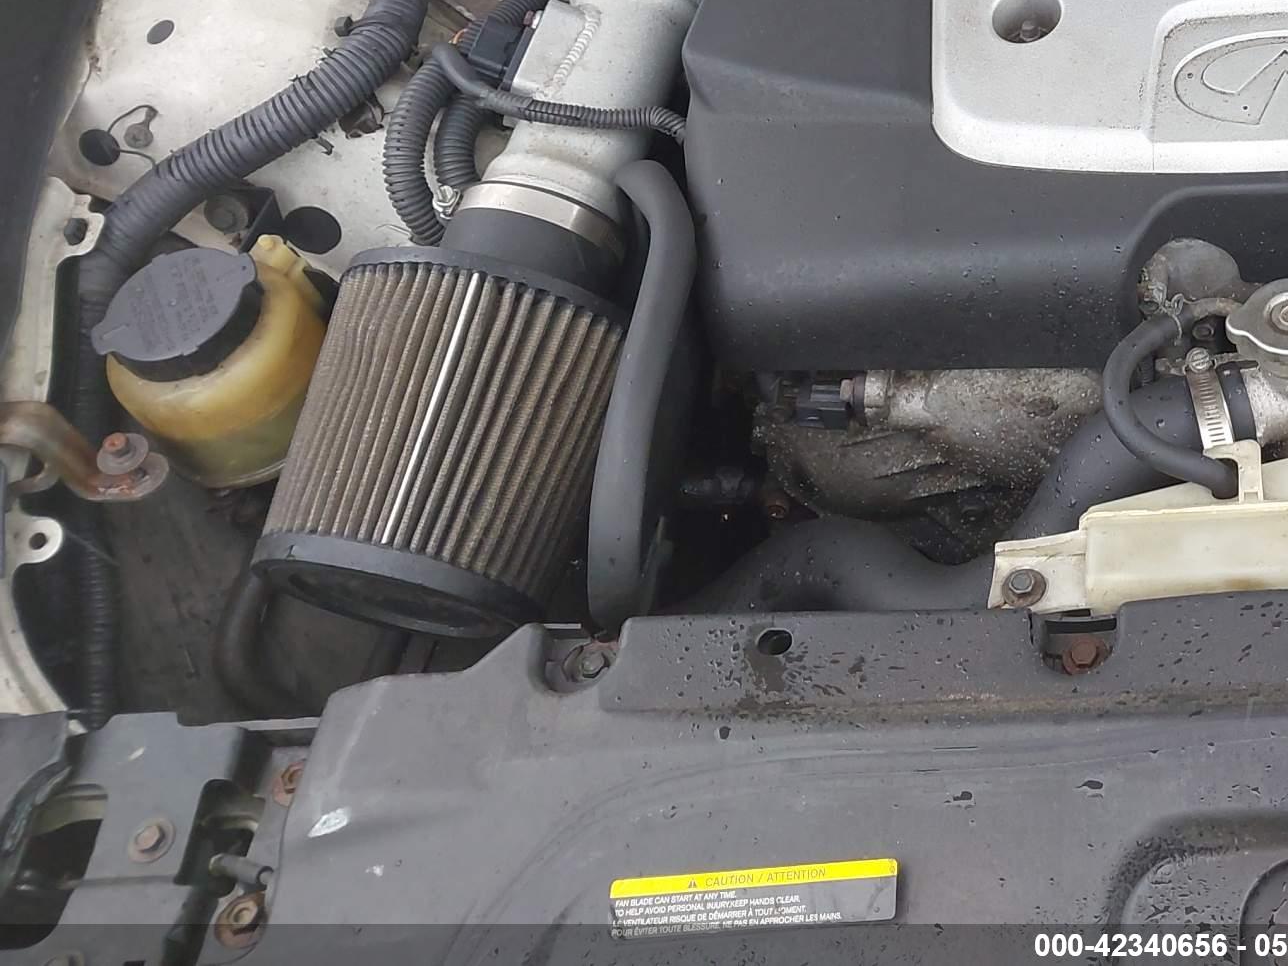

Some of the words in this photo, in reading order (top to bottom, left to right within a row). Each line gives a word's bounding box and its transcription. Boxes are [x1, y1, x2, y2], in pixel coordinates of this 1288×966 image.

[705, 875, 754, 887] CAUTION
[766, 868, 826, 882] ATTENTION
[615, 898, 629, 908] FAN
[630, 897, 653, 907] BLADE
[654, 895, 670, 905] CAN
[671, 893, 693, 903] START
[693, 892, 704, 902] AT
[704, 891, 720, 901] ANY
[615, 908, 625, 917] TO
[625, 907, 644, 916] HELP
[644, 905, 666, 915] AVOID
[667, 902, 705, 913] PERSONAL
[749, 897, 775, 906] HANDS
[611, 928, 633, 938] POUR
[660, 924, 682, 934] TOUTE
[722, 920, 733, 929] NE
[733, 919, 748, 928] PAS
[748, 918, 759, 927] EN
[760, 914, 805, 925] APPROCHER
[805, 913, 819, 923] LES
[623, 916, 668, 927] VENTILATEUR
[669, 914, 696, 924] RISQUE
[697, 912, 707, 922] DE
[754, 906, 773, 916] TOUT
